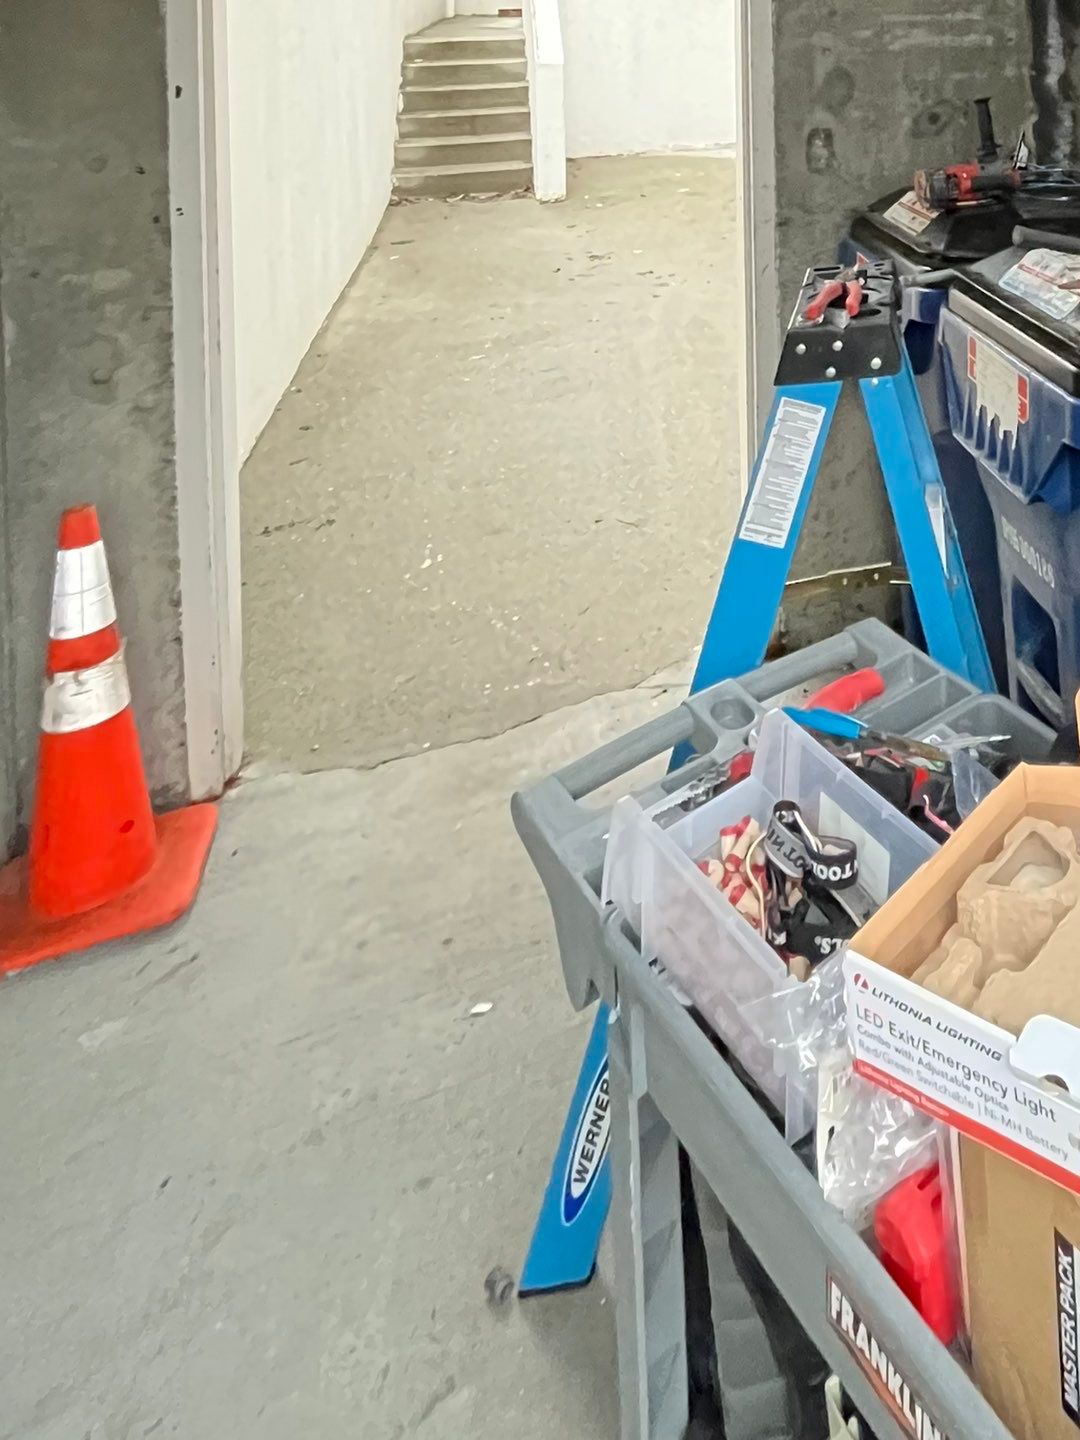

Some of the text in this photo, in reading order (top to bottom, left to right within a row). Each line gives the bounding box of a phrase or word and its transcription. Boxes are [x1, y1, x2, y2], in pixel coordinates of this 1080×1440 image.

[856, 1003, 884, 1029] LED
[888, 1021, 1008, 1099] Exit/Emergency
[1014, 1086, 1056, 1122] Light
[857, 1023, 891, 1050] Combo
[895, 1043, 914, 1063] with
[917, 1054, 971, 1094] Adjustable
[974, 1084, 1009, 1112] Optics
[872, 986, 1003, 1061] LITHONIA LIGHTING
[858, 1038, 915, 1076] Red/Green
[1025, 1126, 1068, 1161] Battery
[1057, 1244, 1080, 1413] MASTER PACK
